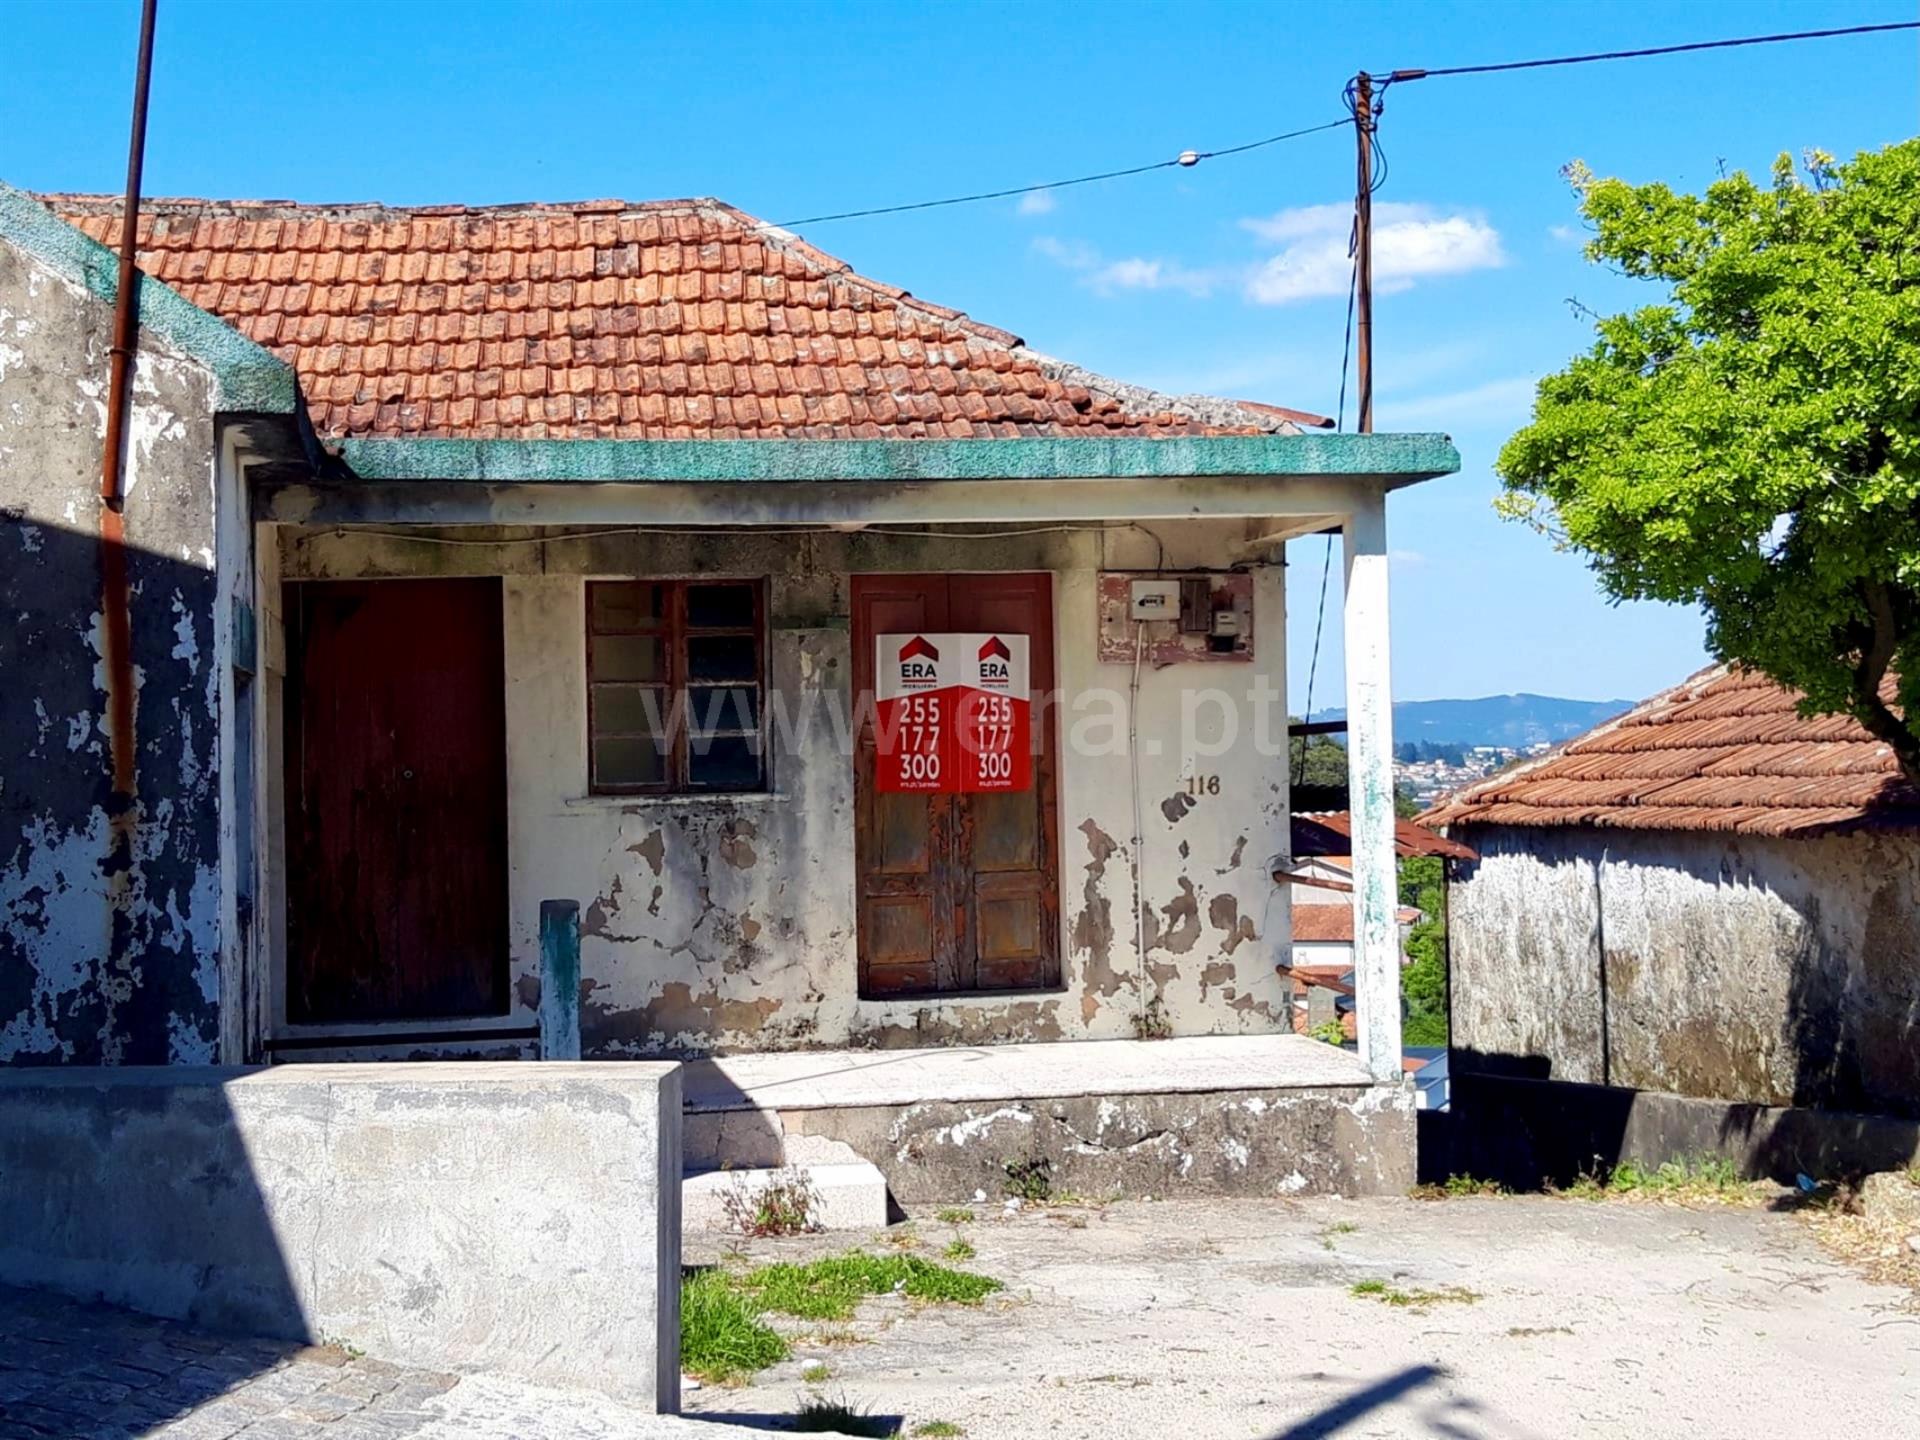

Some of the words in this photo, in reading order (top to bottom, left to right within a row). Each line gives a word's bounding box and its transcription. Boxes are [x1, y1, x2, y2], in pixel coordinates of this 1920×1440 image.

[901, 663, 937, 678] ERA
[980, 663, 1009, 678] ERA
[900, 698, 940, 724] 255
[978, 697, 1011, 723] 255
[900, 726, 940, 752] 177
[978, 725, 1011, 751] 177
[900, 754, 940, 780] 300
[978, 753, 1011, 779] 300
[1186, 775, 1221, 796] 116
